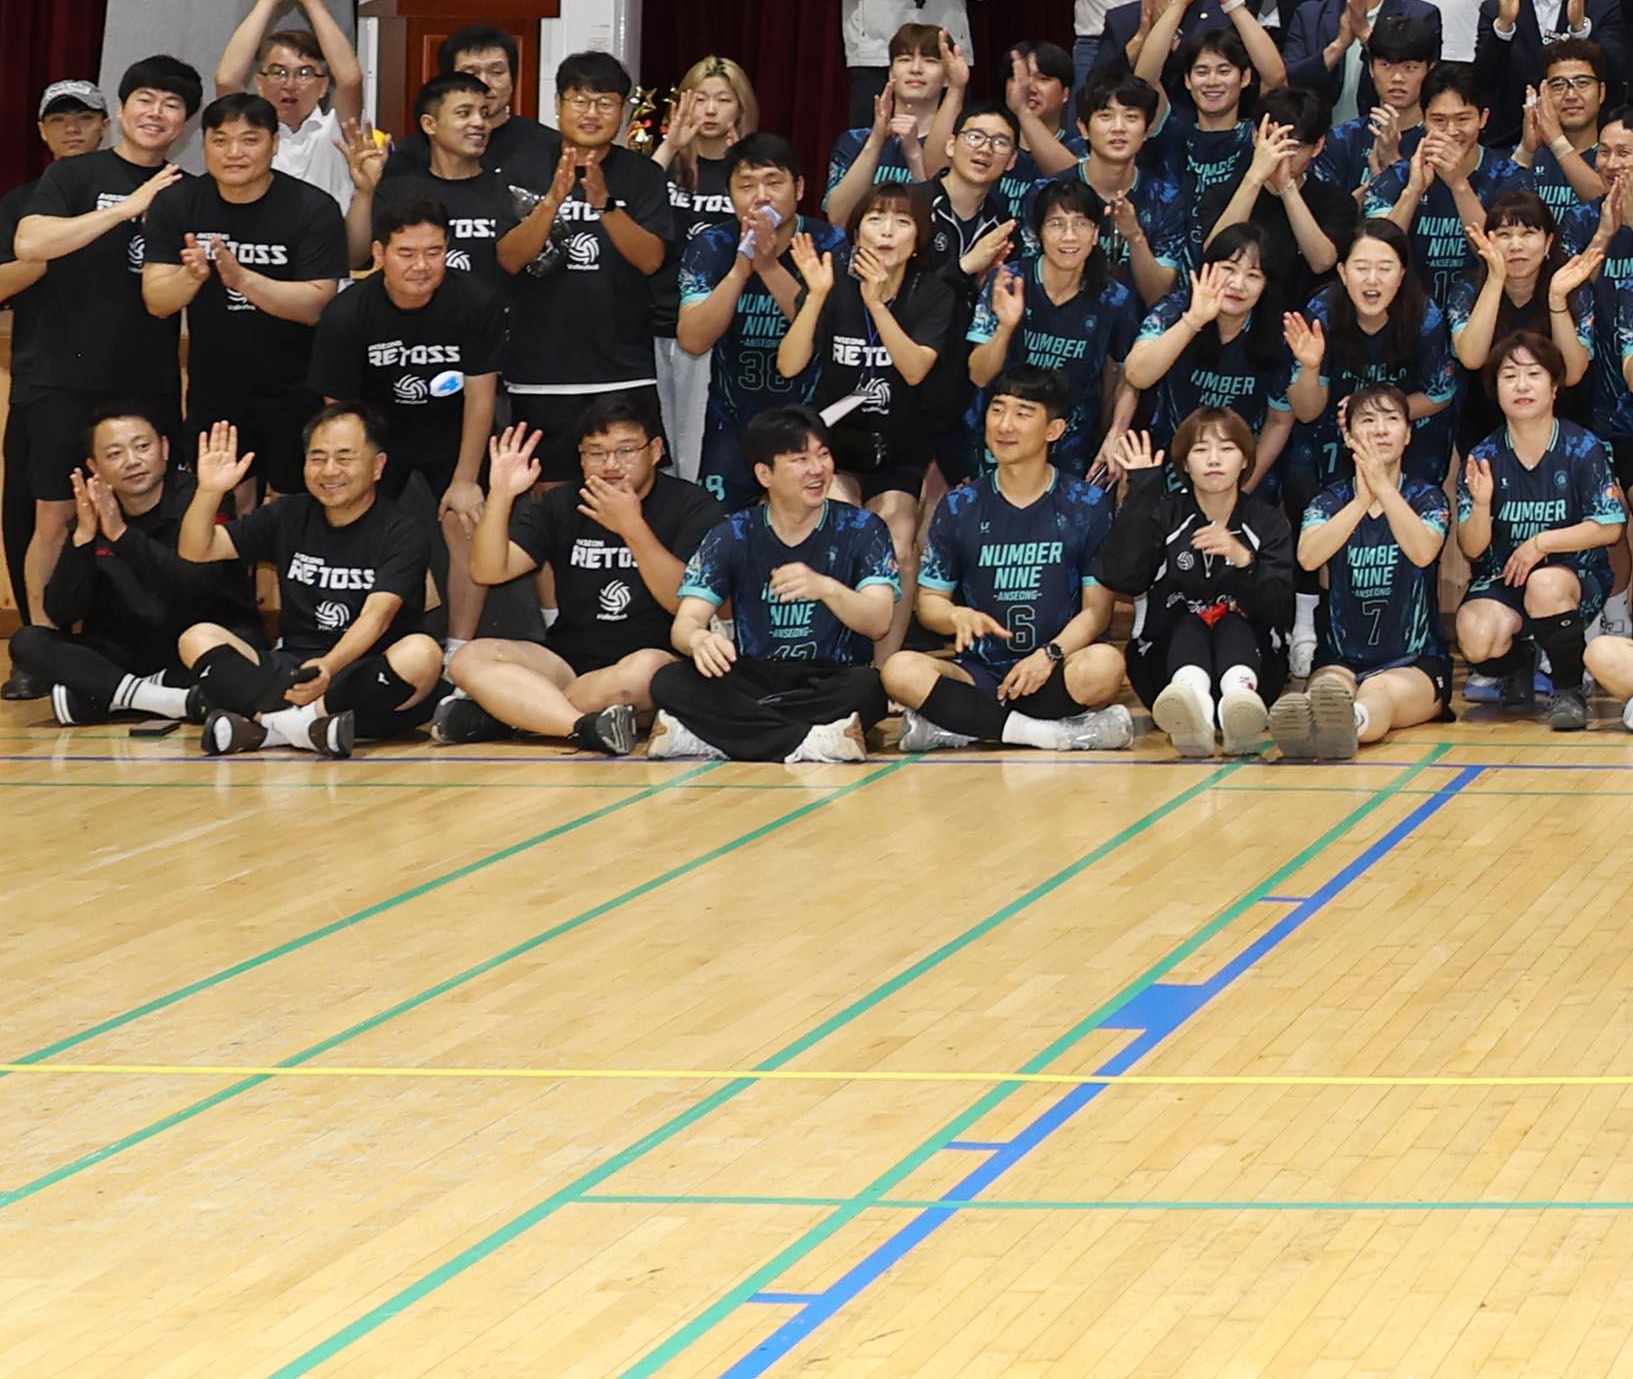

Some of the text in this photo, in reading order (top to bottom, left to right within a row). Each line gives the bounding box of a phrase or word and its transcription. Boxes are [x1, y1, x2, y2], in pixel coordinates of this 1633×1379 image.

[1428, 238, 1467, 257] NINE
[743, 316, 787, 336] NINE
[368, 345, 461, 367] RETOSS
[1498, 499, 1567, 524] NUMBER
[978, 541, 1064, 568] NUMBER
[287, 558, 375, 590] RETOSS
[994, 565, 1043, 590] NINE
[1351, 566, 1396, 588] NINE
[770, 603, 817, 627] NINE
[1362, 599, 1389, 645] 7
[1005, 604, 1037, 653] 6
